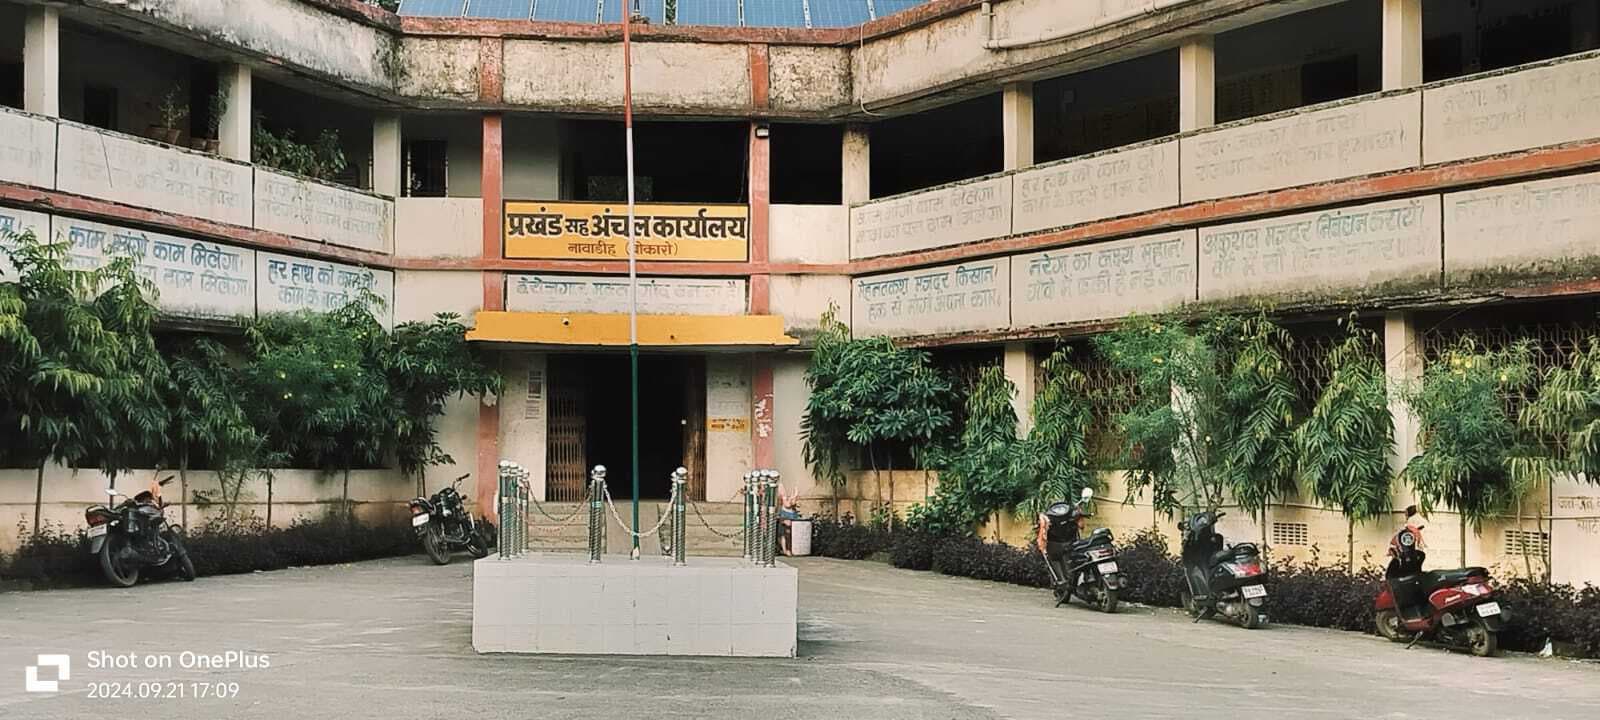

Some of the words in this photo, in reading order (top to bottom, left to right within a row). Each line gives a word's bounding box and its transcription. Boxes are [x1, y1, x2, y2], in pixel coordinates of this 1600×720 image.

[507, 206, 563, 237] प्रखंड
[566, 218, 589, 237] सह
[591, 208, 651, 239] अंचल
[652, 208, 746, 239] कार्यालय
[69, 226, 106, 249] काम
[153, 240, 186, 263] काम
[568, 242, 617, 257] नावाडीह
[269, 260, 287, 284] हर
[292, 263, 314, 285] हाथ
[318, 264, 334, 285] को
